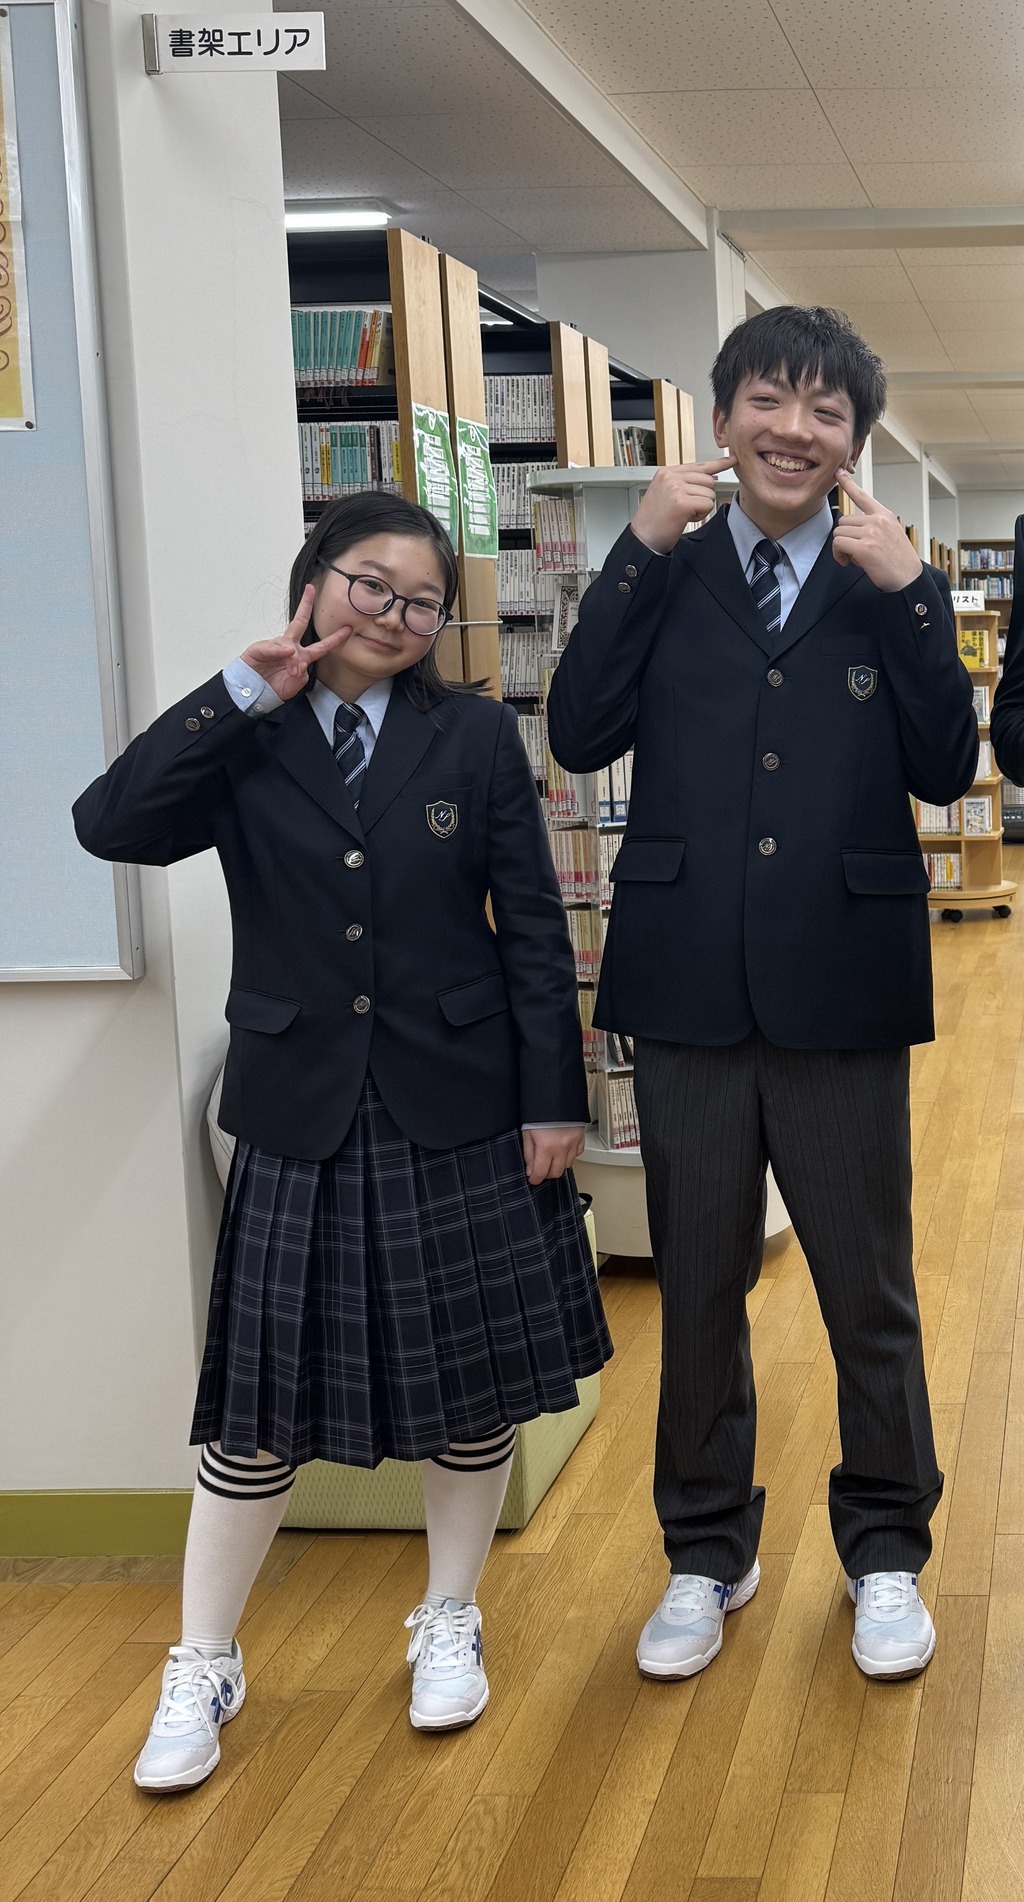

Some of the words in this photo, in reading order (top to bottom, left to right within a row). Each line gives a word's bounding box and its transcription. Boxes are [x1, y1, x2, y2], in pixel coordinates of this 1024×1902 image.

[168, 27, 311, 58] 書架エリア
